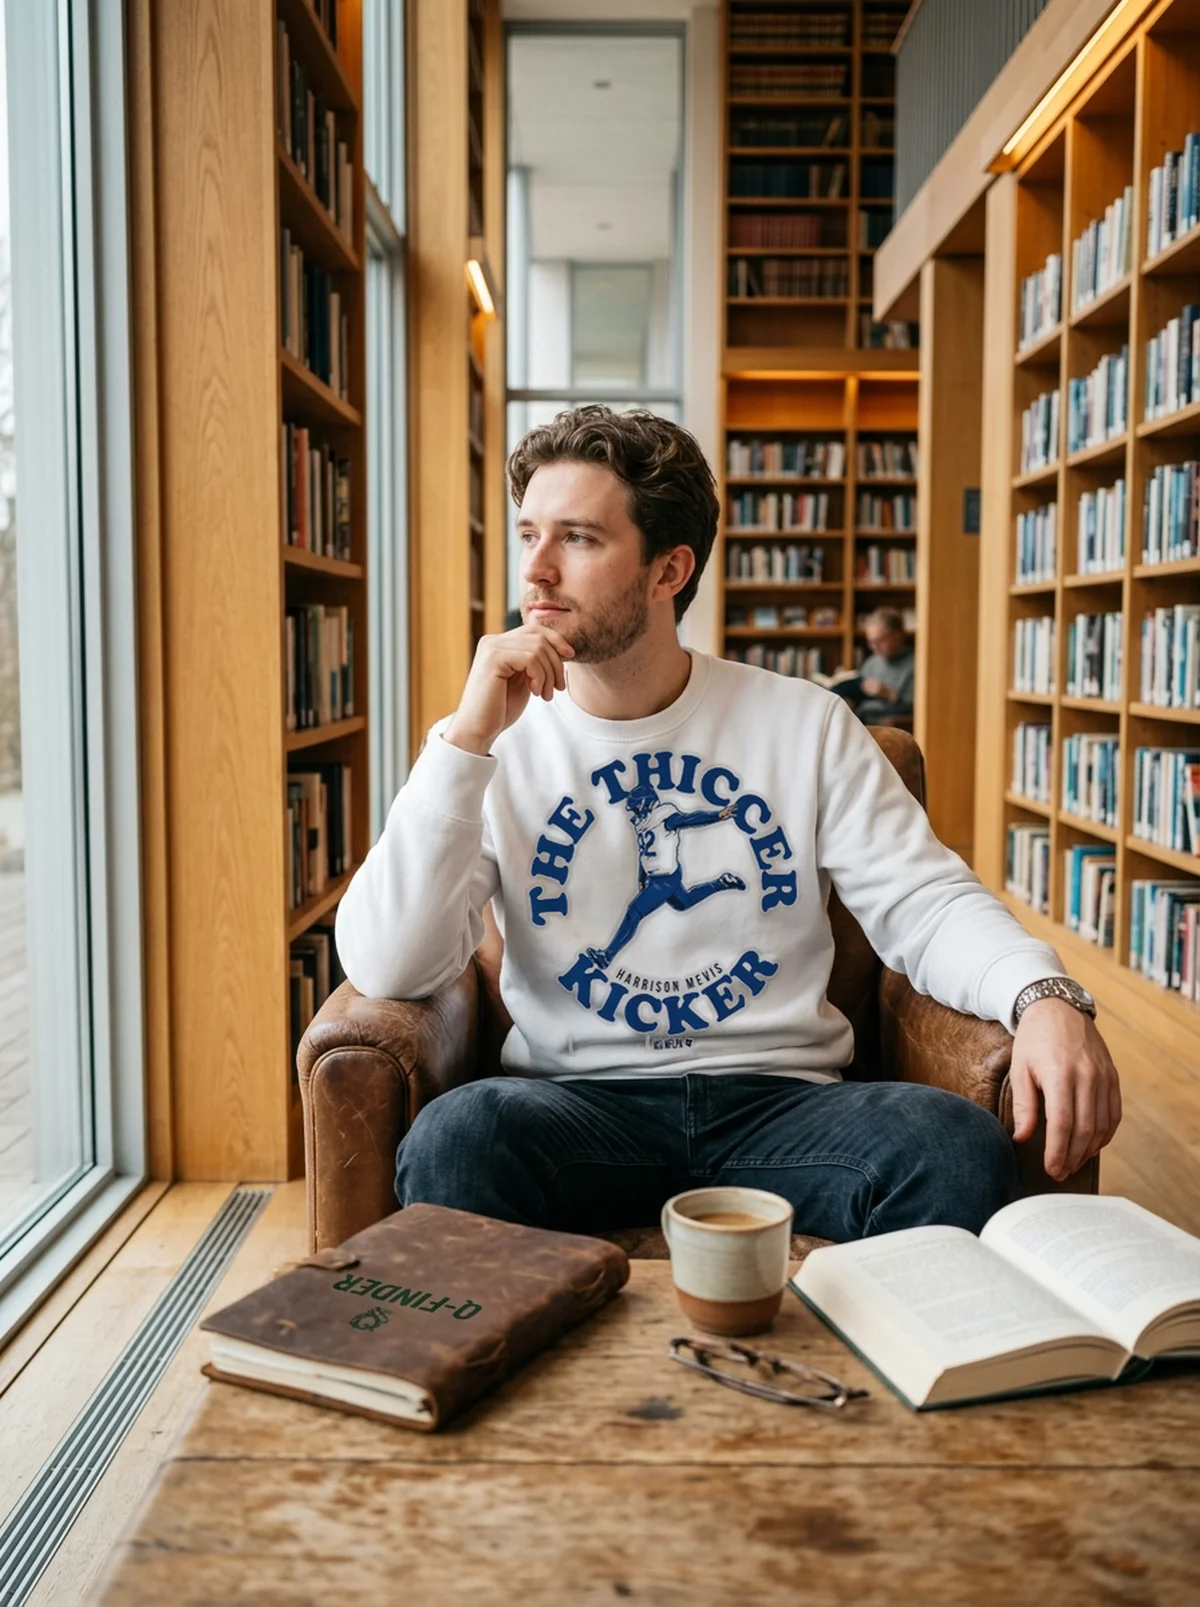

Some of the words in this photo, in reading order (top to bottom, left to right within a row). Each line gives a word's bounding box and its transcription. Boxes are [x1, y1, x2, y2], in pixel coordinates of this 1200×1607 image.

[529, 796, 595, 926] THE
[591, 751, 797, 912] THICCER
[558, 950, 779, 1035] KICKER
[616, 968, 680, 993] HARRISON
[685, 962, 723, 989] MEVIS
[333, 1274, 482, 1320] Q-FINDER
